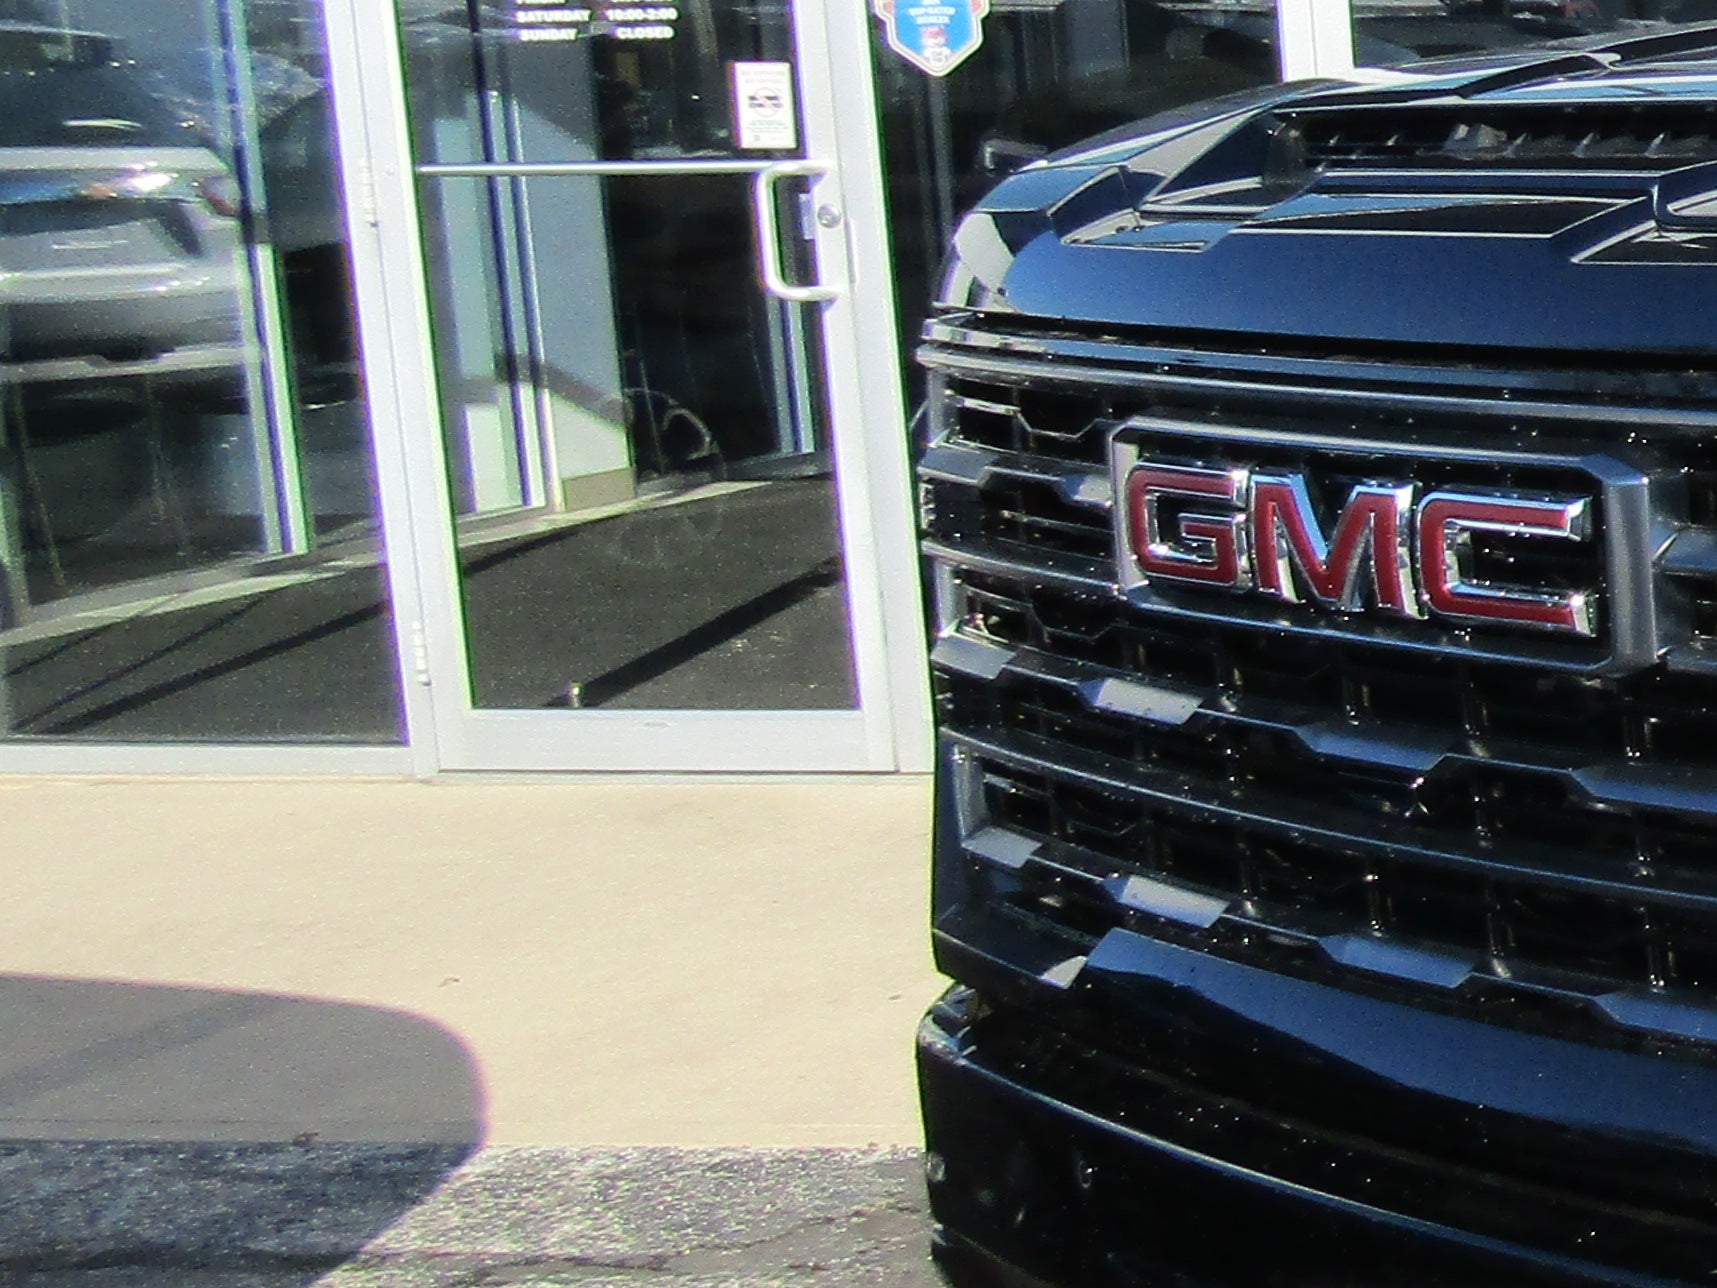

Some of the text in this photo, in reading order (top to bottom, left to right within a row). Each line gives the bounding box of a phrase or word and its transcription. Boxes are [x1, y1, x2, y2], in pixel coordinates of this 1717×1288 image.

[516, 10, 591, 23] SATURDAY
[519, 26, 674, 41] SUNDAY CLOSED
[1126, 461, 1596, 637] GMC
